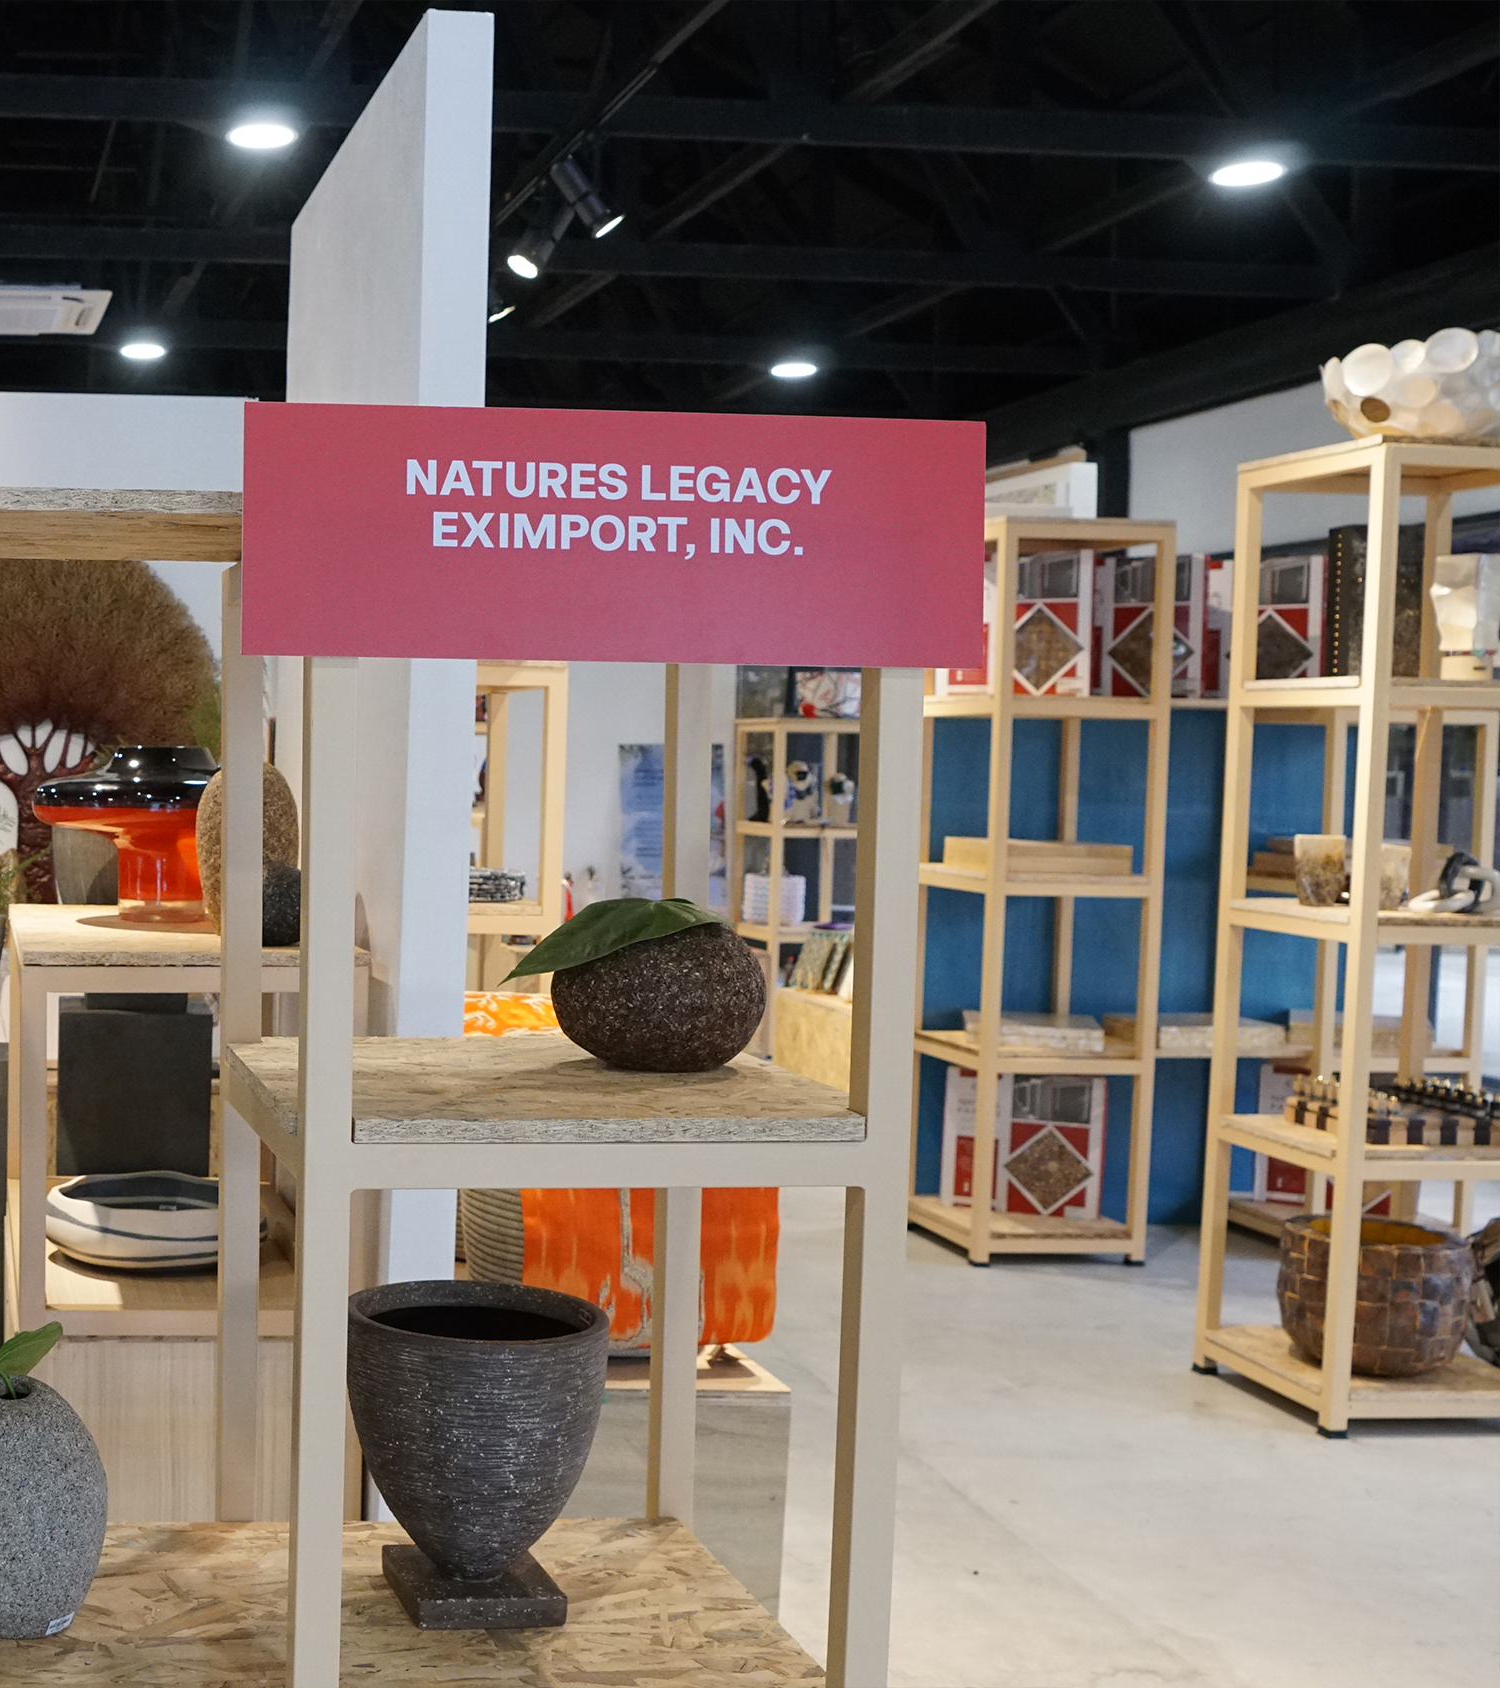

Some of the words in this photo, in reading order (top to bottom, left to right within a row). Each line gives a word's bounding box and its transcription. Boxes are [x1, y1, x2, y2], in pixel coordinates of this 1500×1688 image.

[406, 459, 628, 500] NATURES
[641, 464, 832, 504] LEGACY
[432, 511, 697, 560] EXIMPORT,
[709, 517, 804, 556] INC.
